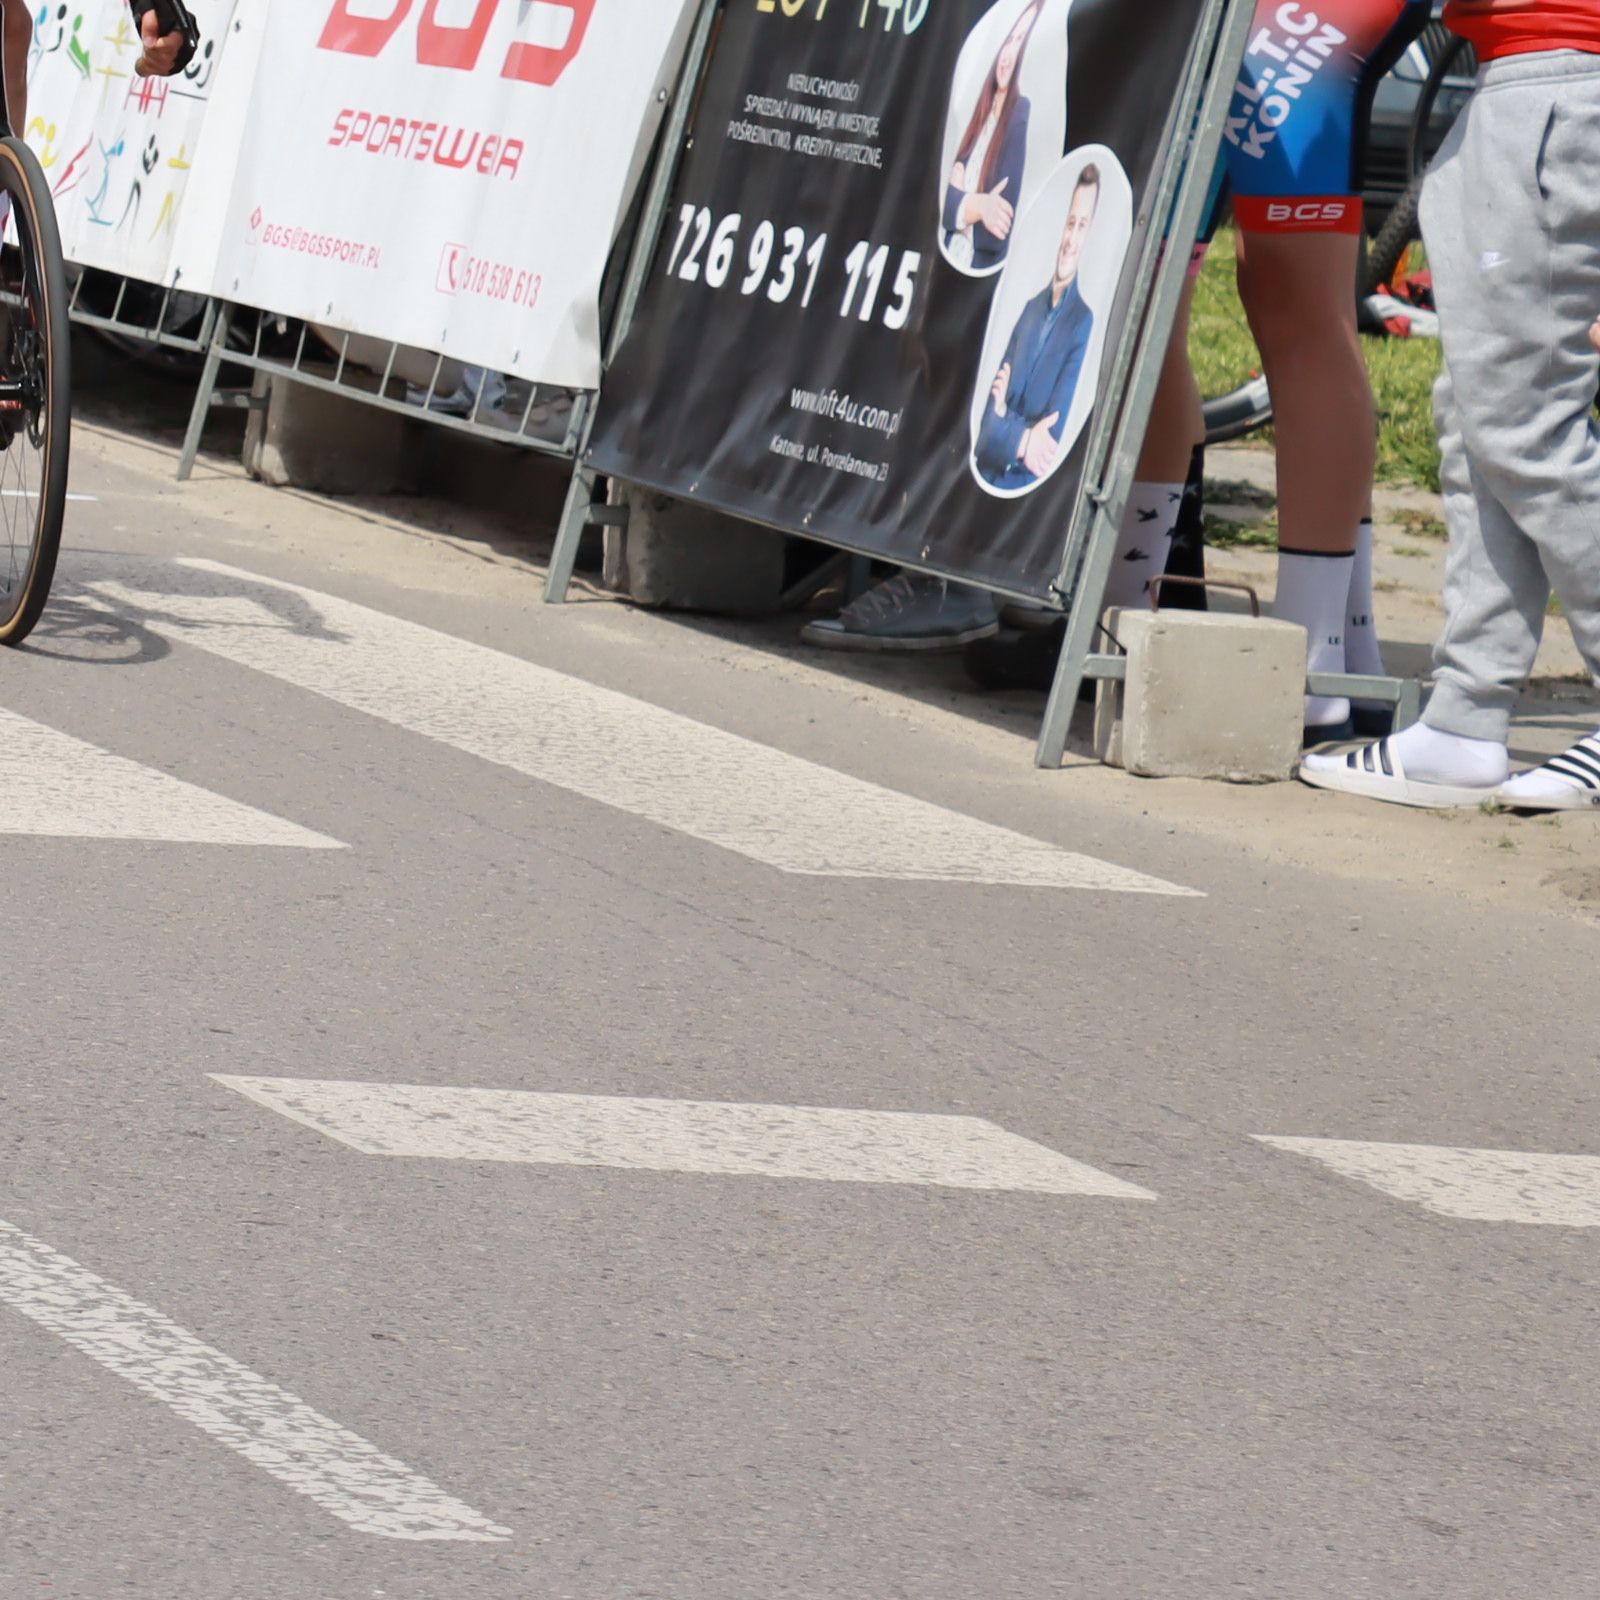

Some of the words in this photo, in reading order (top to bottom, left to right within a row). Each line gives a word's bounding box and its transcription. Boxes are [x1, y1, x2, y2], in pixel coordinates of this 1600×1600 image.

[744, 94, 789, 119] SPRZEDAŻ
[1241, 22, 1347, 160] KONIN
[1266, 203, 1346, 222] BGS
[262, 223, 382, 270] BGS@BGSSPORT.PL
[667, 203, 742, 289] 726
[740, 219, 827, 309] 931
[839, 240, 921, 330] 115
[462, 257, 490, 294] 518
[513, 270, 542, 309] 613
[790, 388, 904, 441] www.loft4u.com.pl
[806, 444, 820, 464] ul.
